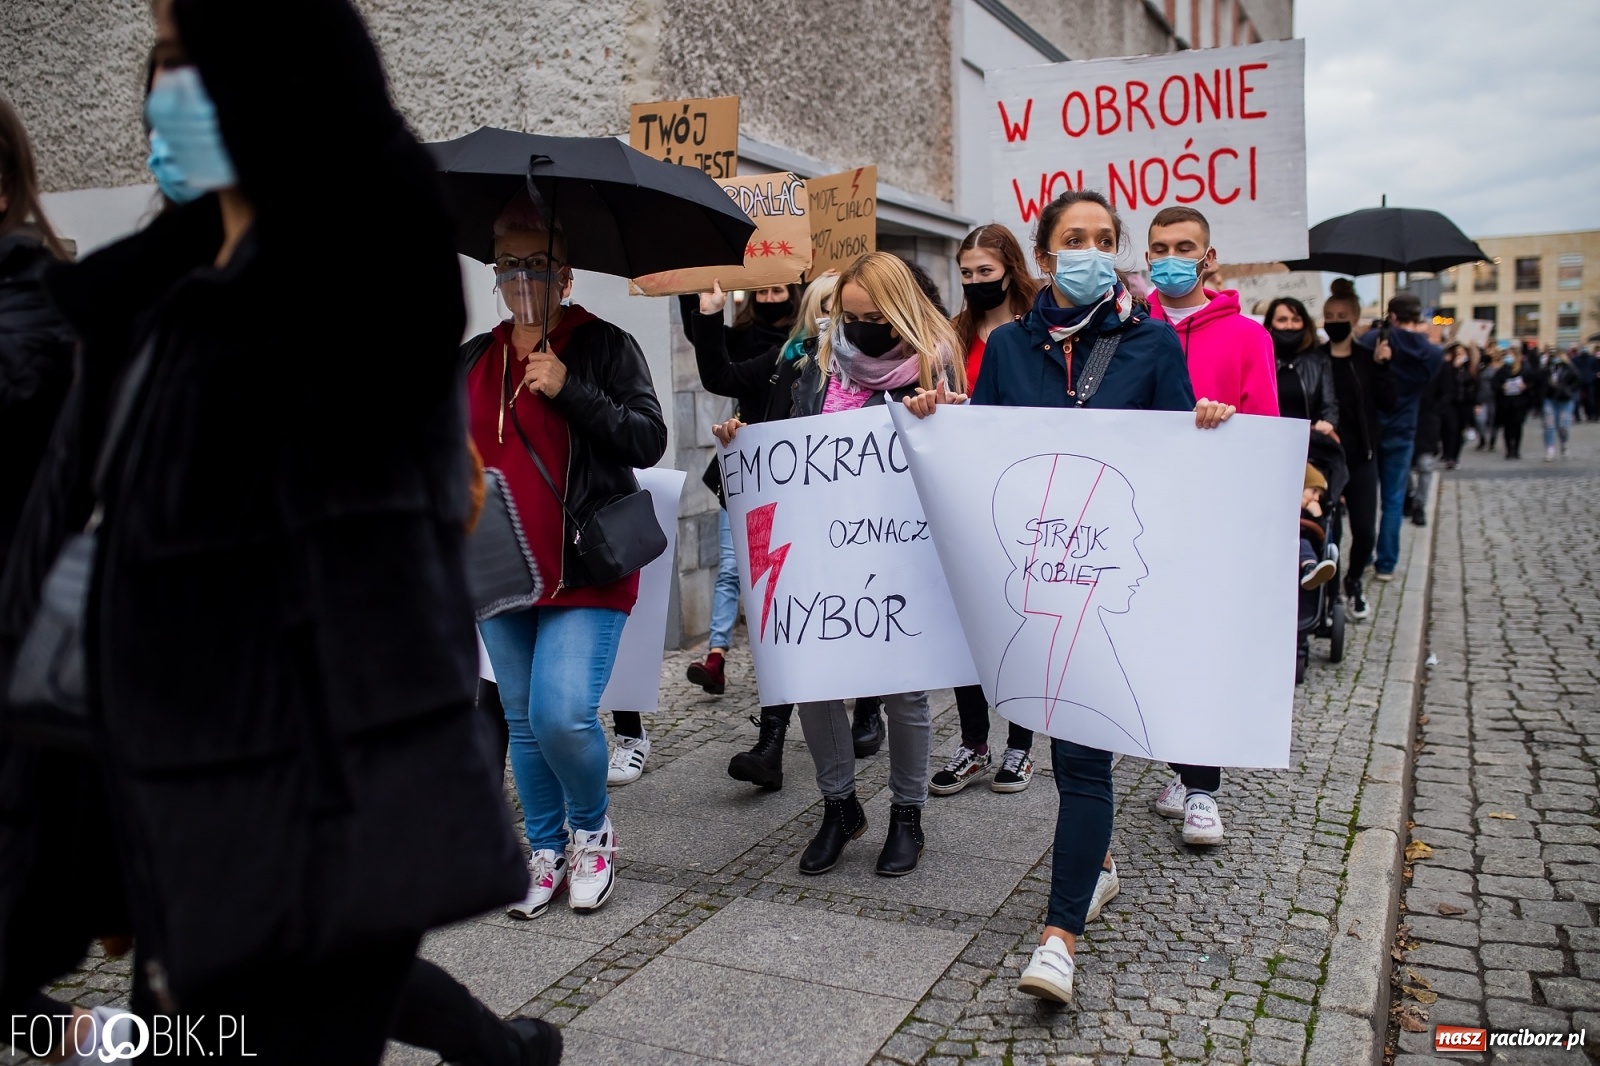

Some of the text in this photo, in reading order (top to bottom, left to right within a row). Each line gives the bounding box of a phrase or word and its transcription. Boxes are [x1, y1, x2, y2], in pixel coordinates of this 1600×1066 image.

[997, 63, 1268, 142] W OBRONIE
[638, 104, 707, 150] TWÓJ
[809, 187, 839, 215] MOJE
[1016, 518, 1109, 558] STRAJK
[1023, 556, 1120, 587] KOBIET
[774, 574, 922, 645] WYBÓR
